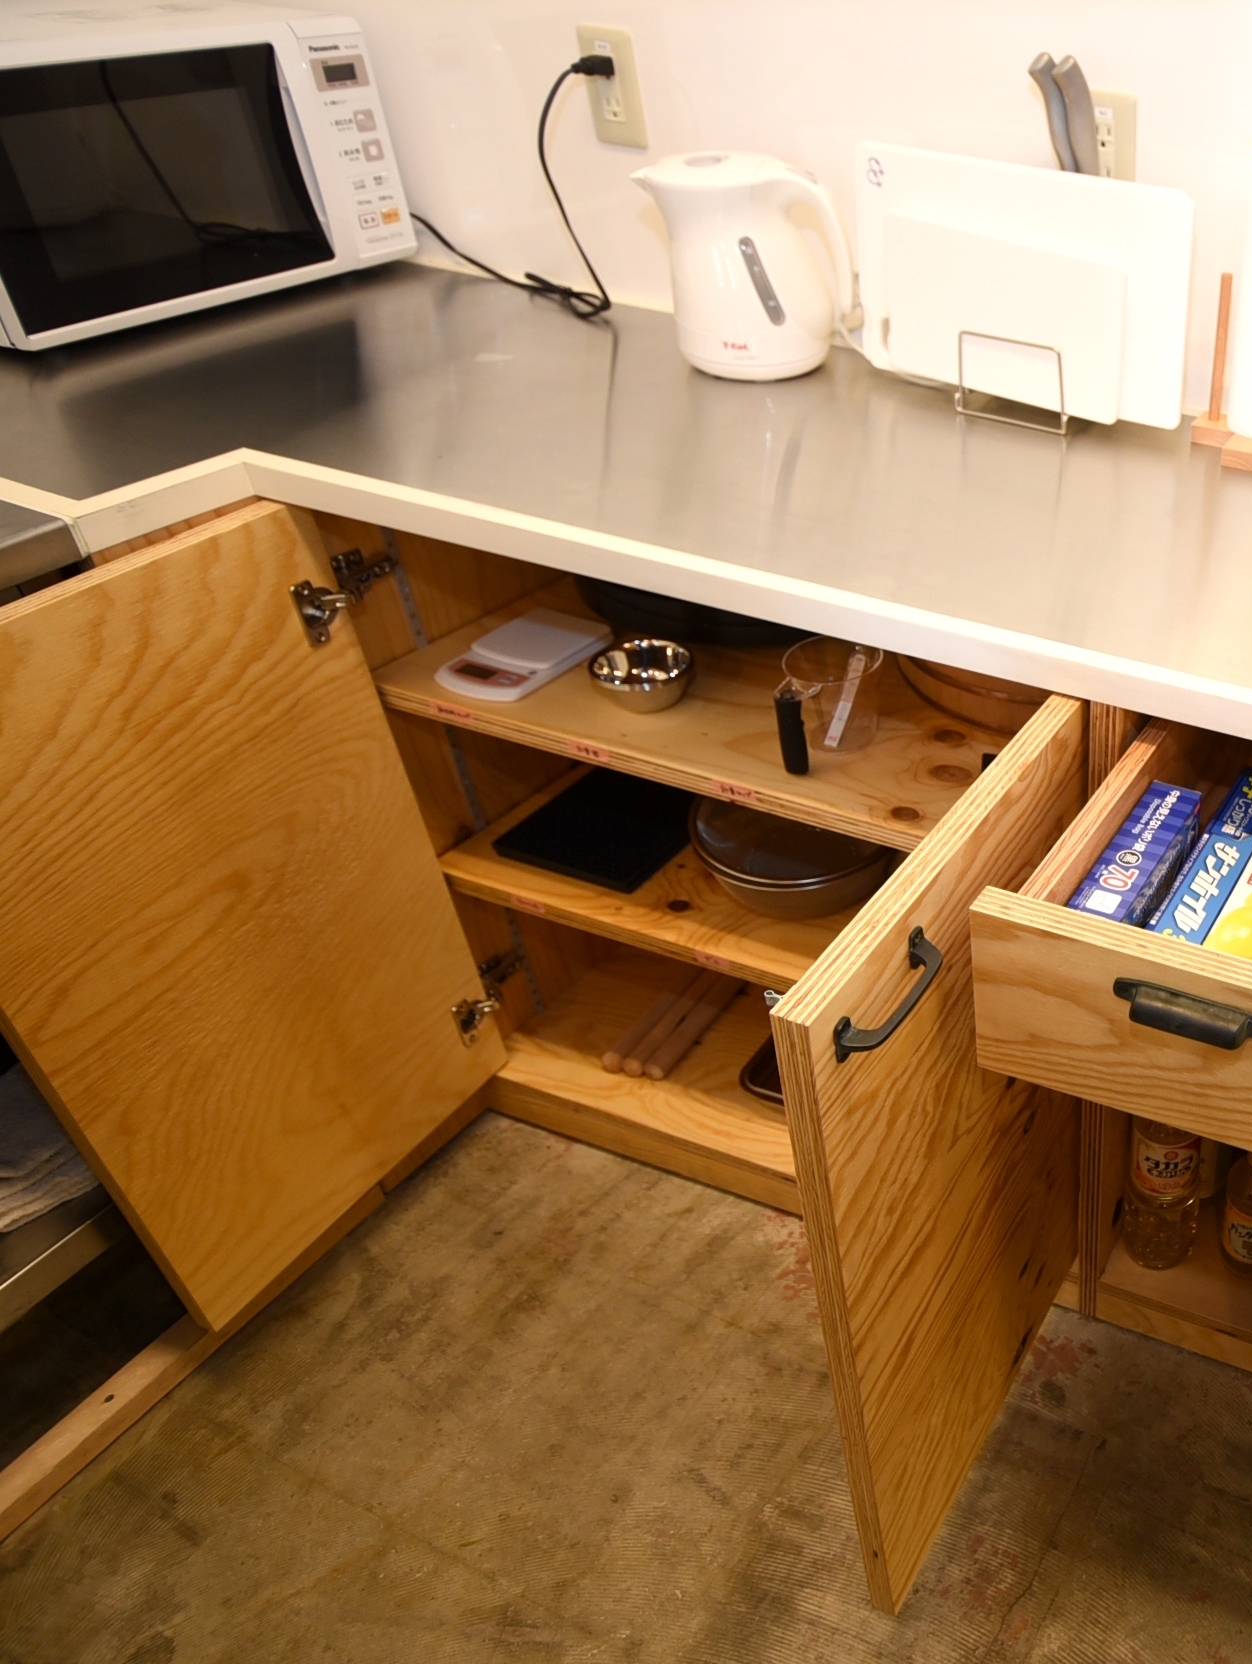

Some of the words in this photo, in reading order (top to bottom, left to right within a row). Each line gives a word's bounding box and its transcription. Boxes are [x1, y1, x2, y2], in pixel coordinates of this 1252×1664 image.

[1132, 790, 1180, 851] 中身の見えないポリ袋
[1101, 865, 1139, 890] 70
[1173, 842, 1240, 933] サンホイル
[1144, 1154, 1194, 1170] タカラ
